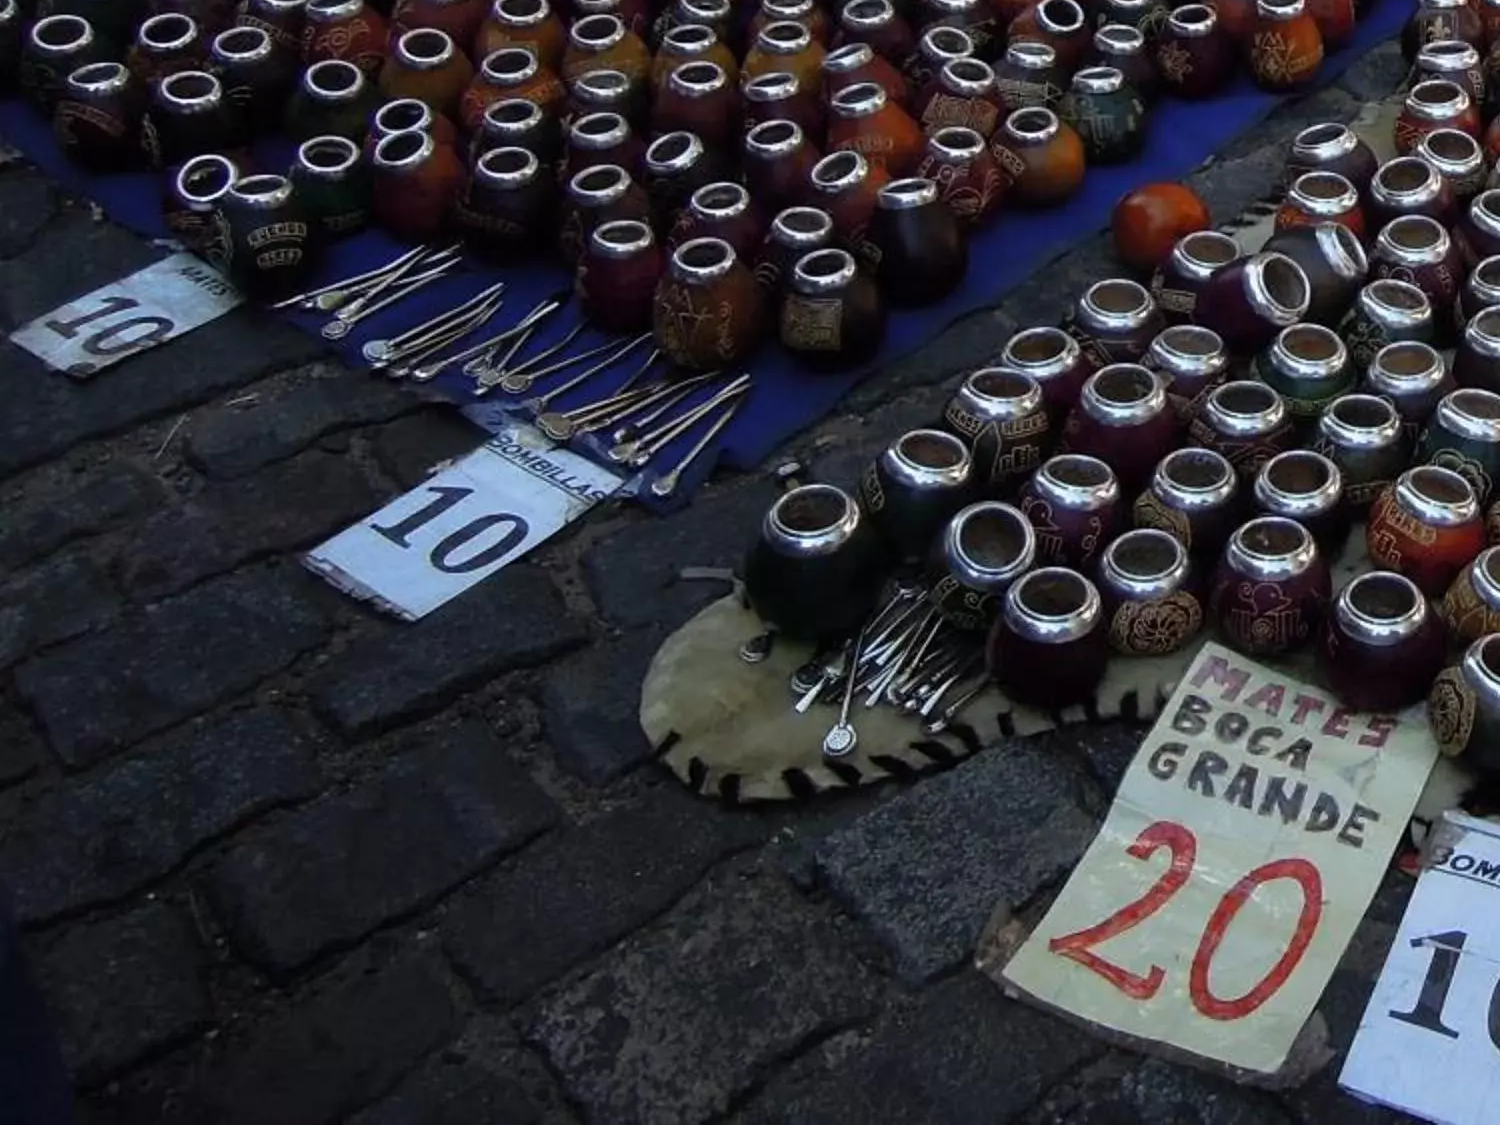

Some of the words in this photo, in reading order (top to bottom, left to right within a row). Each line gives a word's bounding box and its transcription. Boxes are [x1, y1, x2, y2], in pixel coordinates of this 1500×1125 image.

[45, 296, 175, 356] 10
[489, 433, 605, 502] BOMBILLAS
[370, 486, 530, 574] 10
[1172, 695, 1313, 770] BOCA
[1193, 656, 1396, 748] MATES
[1147, 742, 1380, 848] GRANDE
[1050, 820, 1322, 1020] 20
